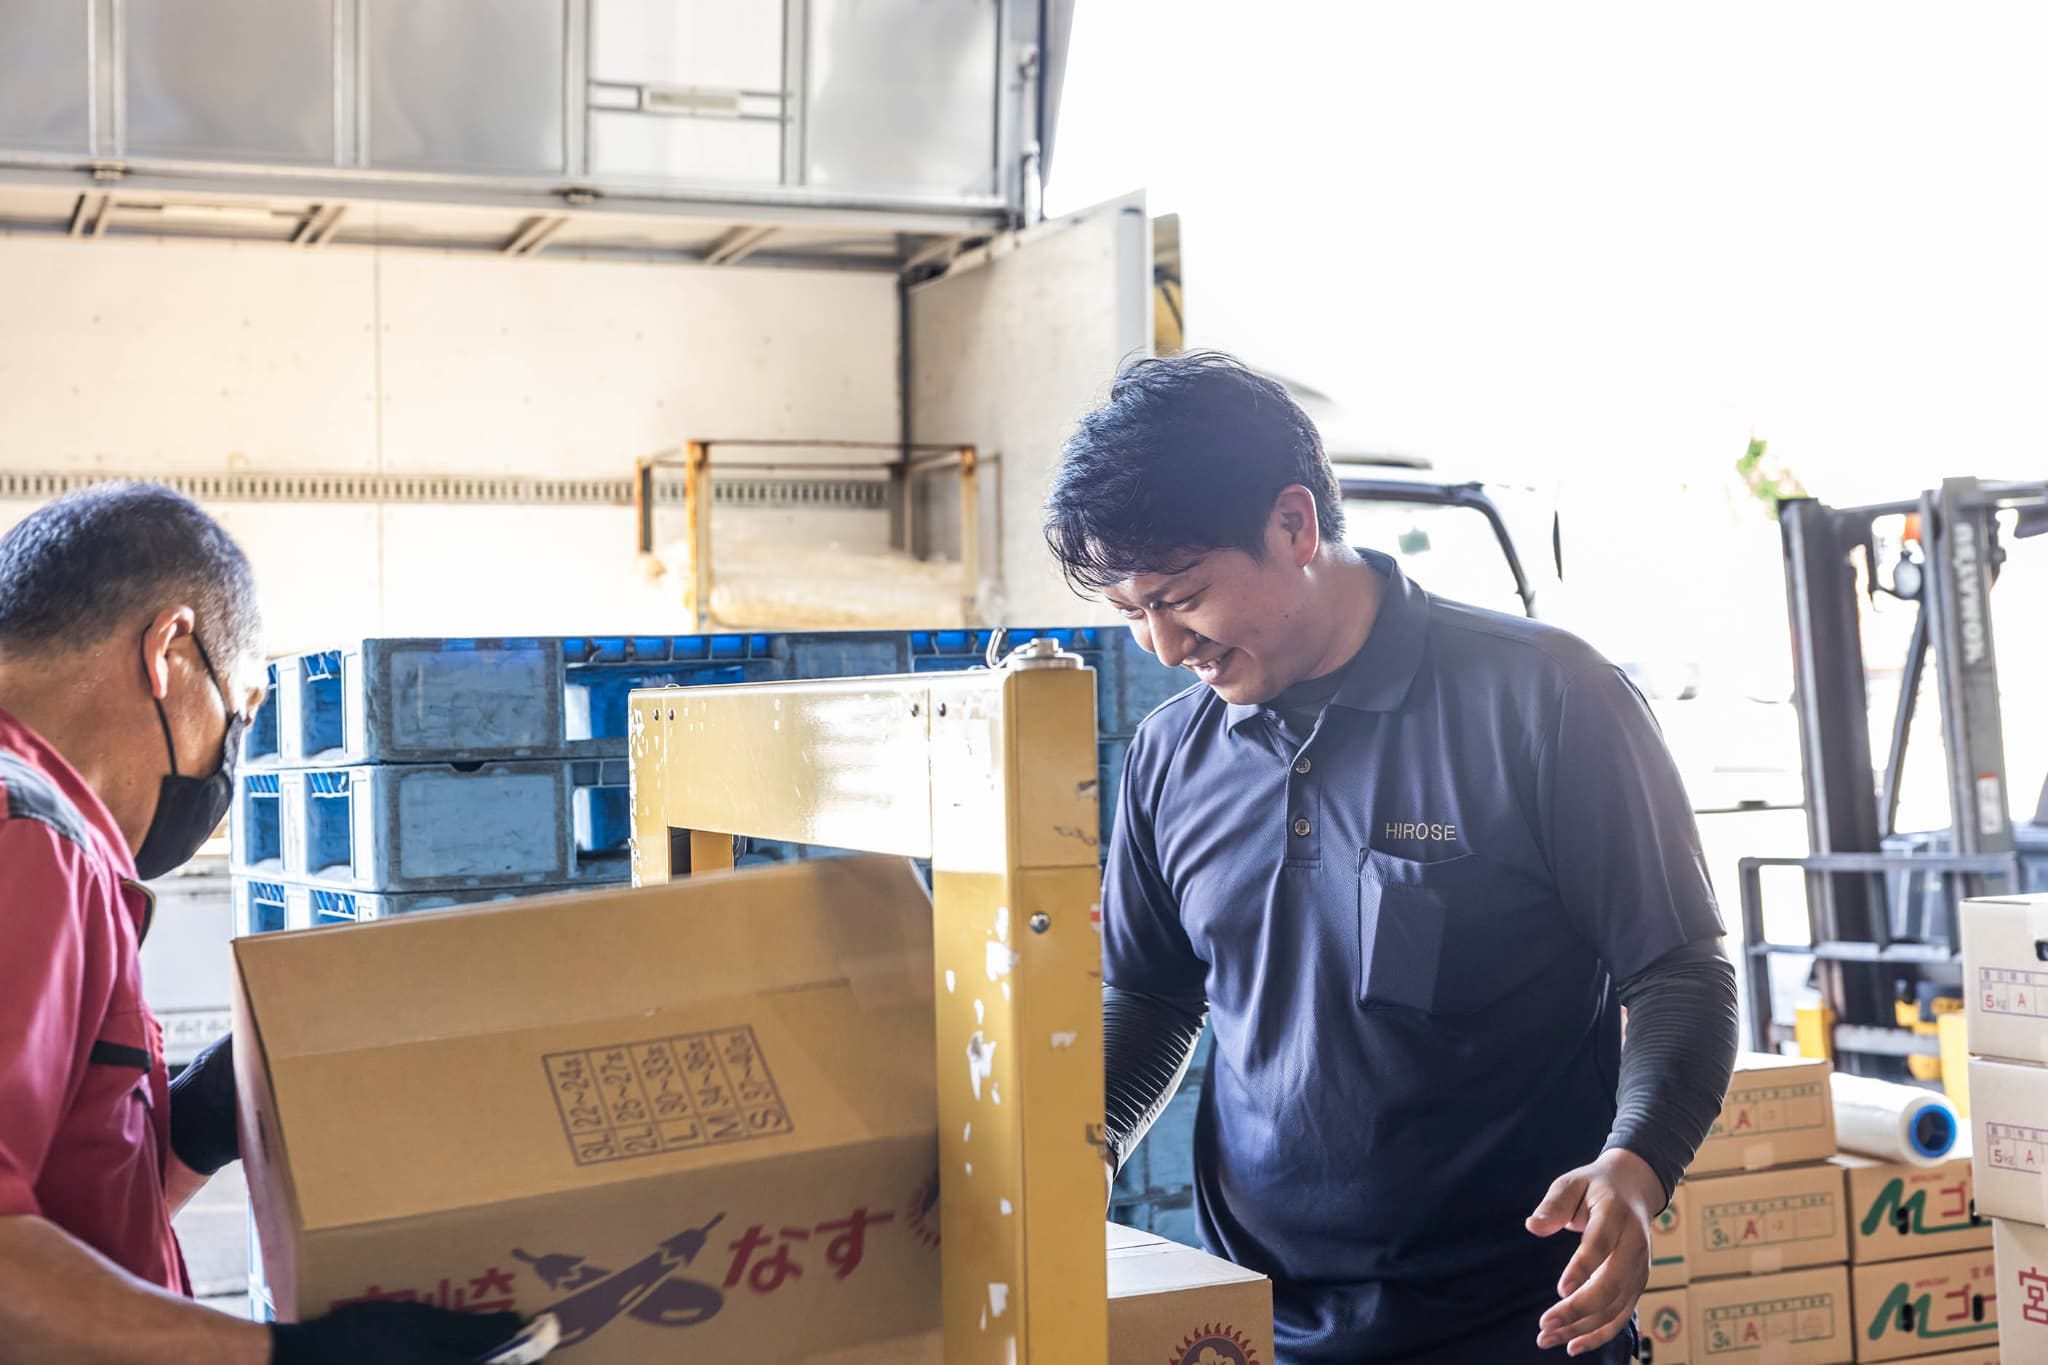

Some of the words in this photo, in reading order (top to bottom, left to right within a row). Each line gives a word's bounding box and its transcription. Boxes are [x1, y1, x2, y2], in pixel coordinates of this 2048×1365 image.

[1385, 822, 1457, 841] HIROSE
[706, 1111, 744, 1139] M
[749, 1108, 783, 1128] S
[1735, 1108, 1753, 1130] A
[624, 1127, 658, 1151] 2L
[668, 1123, 699, 1142] L
[581, 1134, 615, 1158] 3L
[1742, 1219, 1760, 1241] A
[720, 1208, 896, 1294] なす
[1743, 1320, 1760, 1342] A
